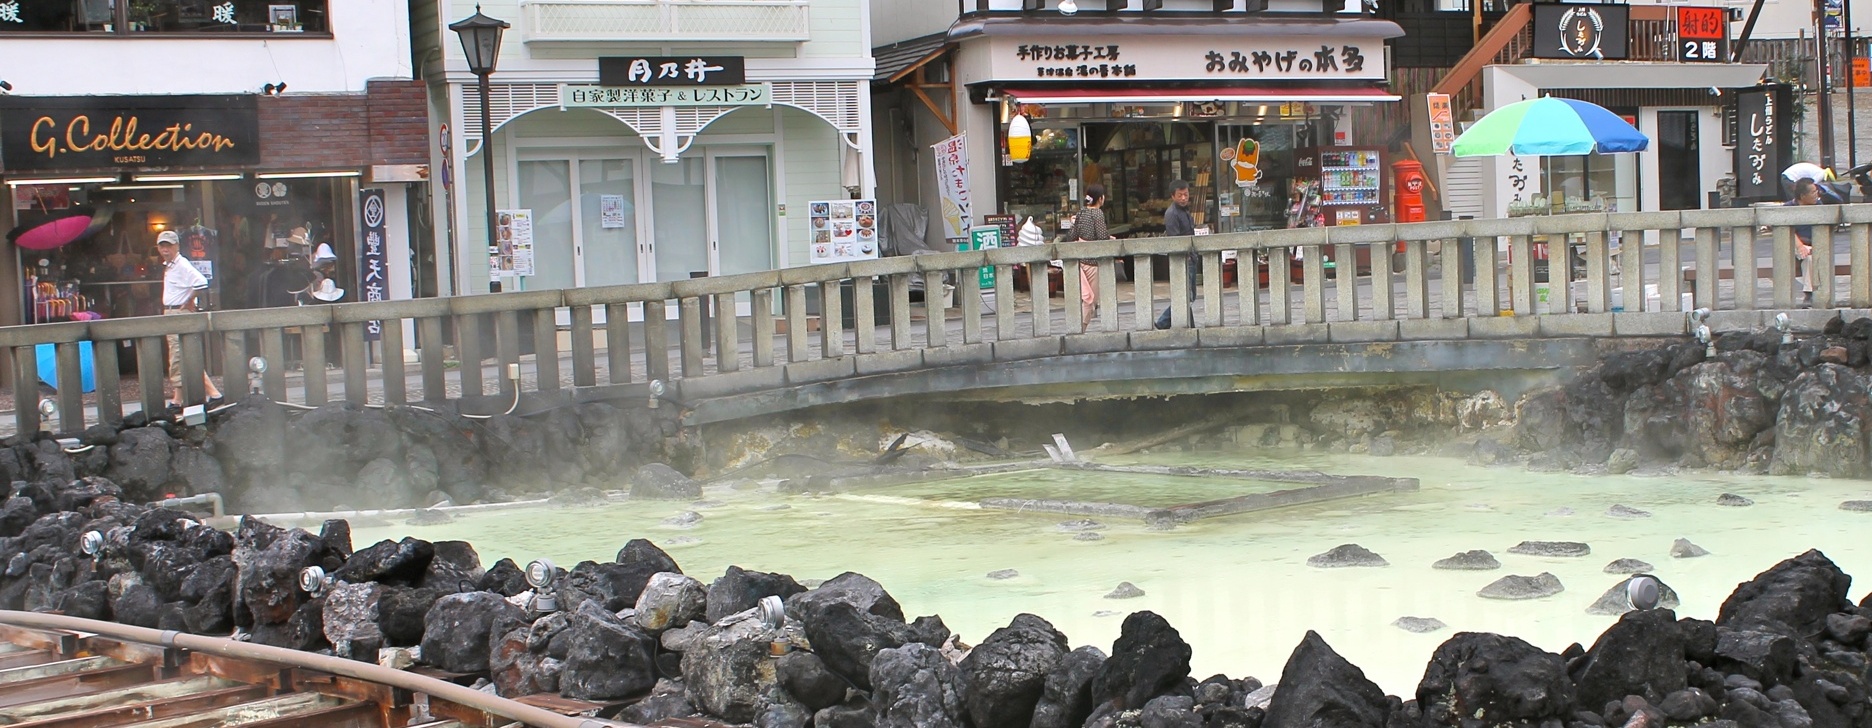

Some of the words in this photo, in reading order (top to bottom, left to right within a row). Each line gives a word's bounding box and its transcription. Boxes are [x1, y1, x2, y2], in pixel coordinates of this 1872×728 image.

[0, 0, 24, 23] 暖
[212, 1, 238, 24] 暖
[1682, 11, 1719, 35] 射的
[1017, 44, 1120, 61] 手作りお菓子工房
[1205, 45, 1365, 73] おみやげの本多
[1685, 41, 1717, 59] 2階
[628, 58, 724, 83] 月乃井
[572, 89, 673, 103] 自家製洋菓子
[677, 91, 687, 101] &
[693, 88, 762, 103] レストラン
[30, 115, 235, 159] G.Collection
[114, 155, 146, 163] KUSATSU
[1748, 113, 1767, 185] したづみ
